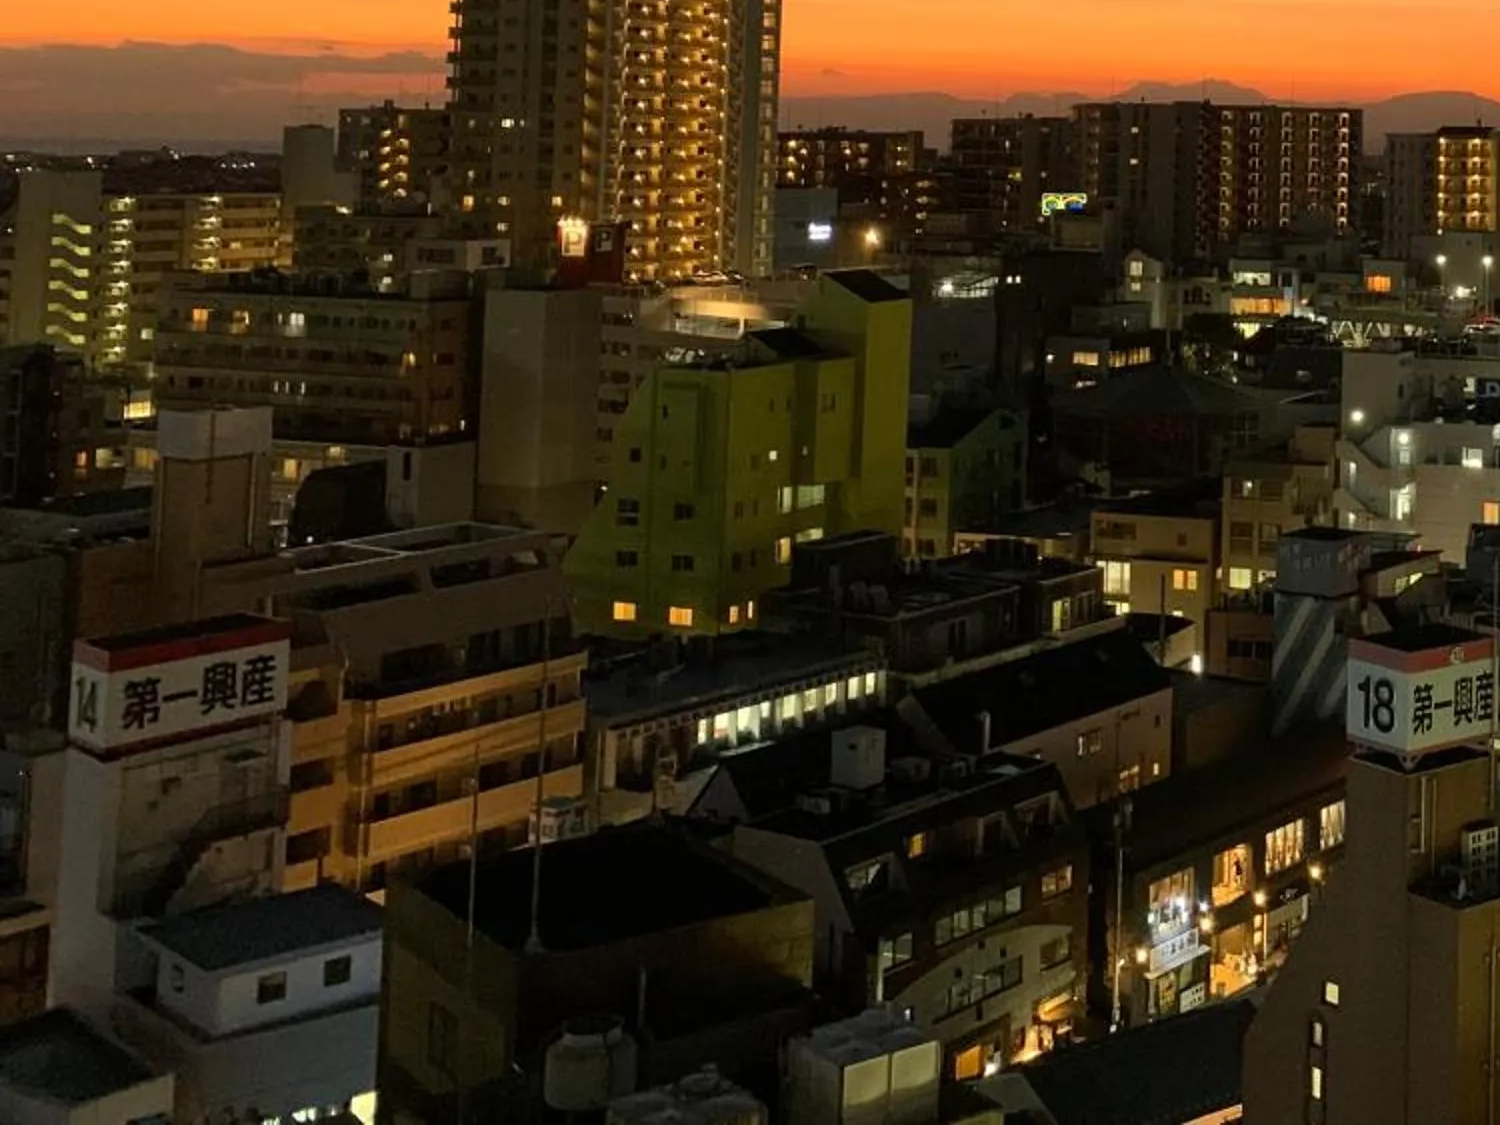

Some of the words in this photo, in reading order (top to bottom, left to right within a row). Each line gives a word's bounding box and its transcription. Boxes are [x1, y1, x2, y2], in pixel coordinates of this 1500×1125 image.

[76, 677, 97, 733] 14
[122, 655, 277, 729] 第一興産
[1358, 676, 1395, 733] 18
[1412, 671, 1493, 735] 第一興産
